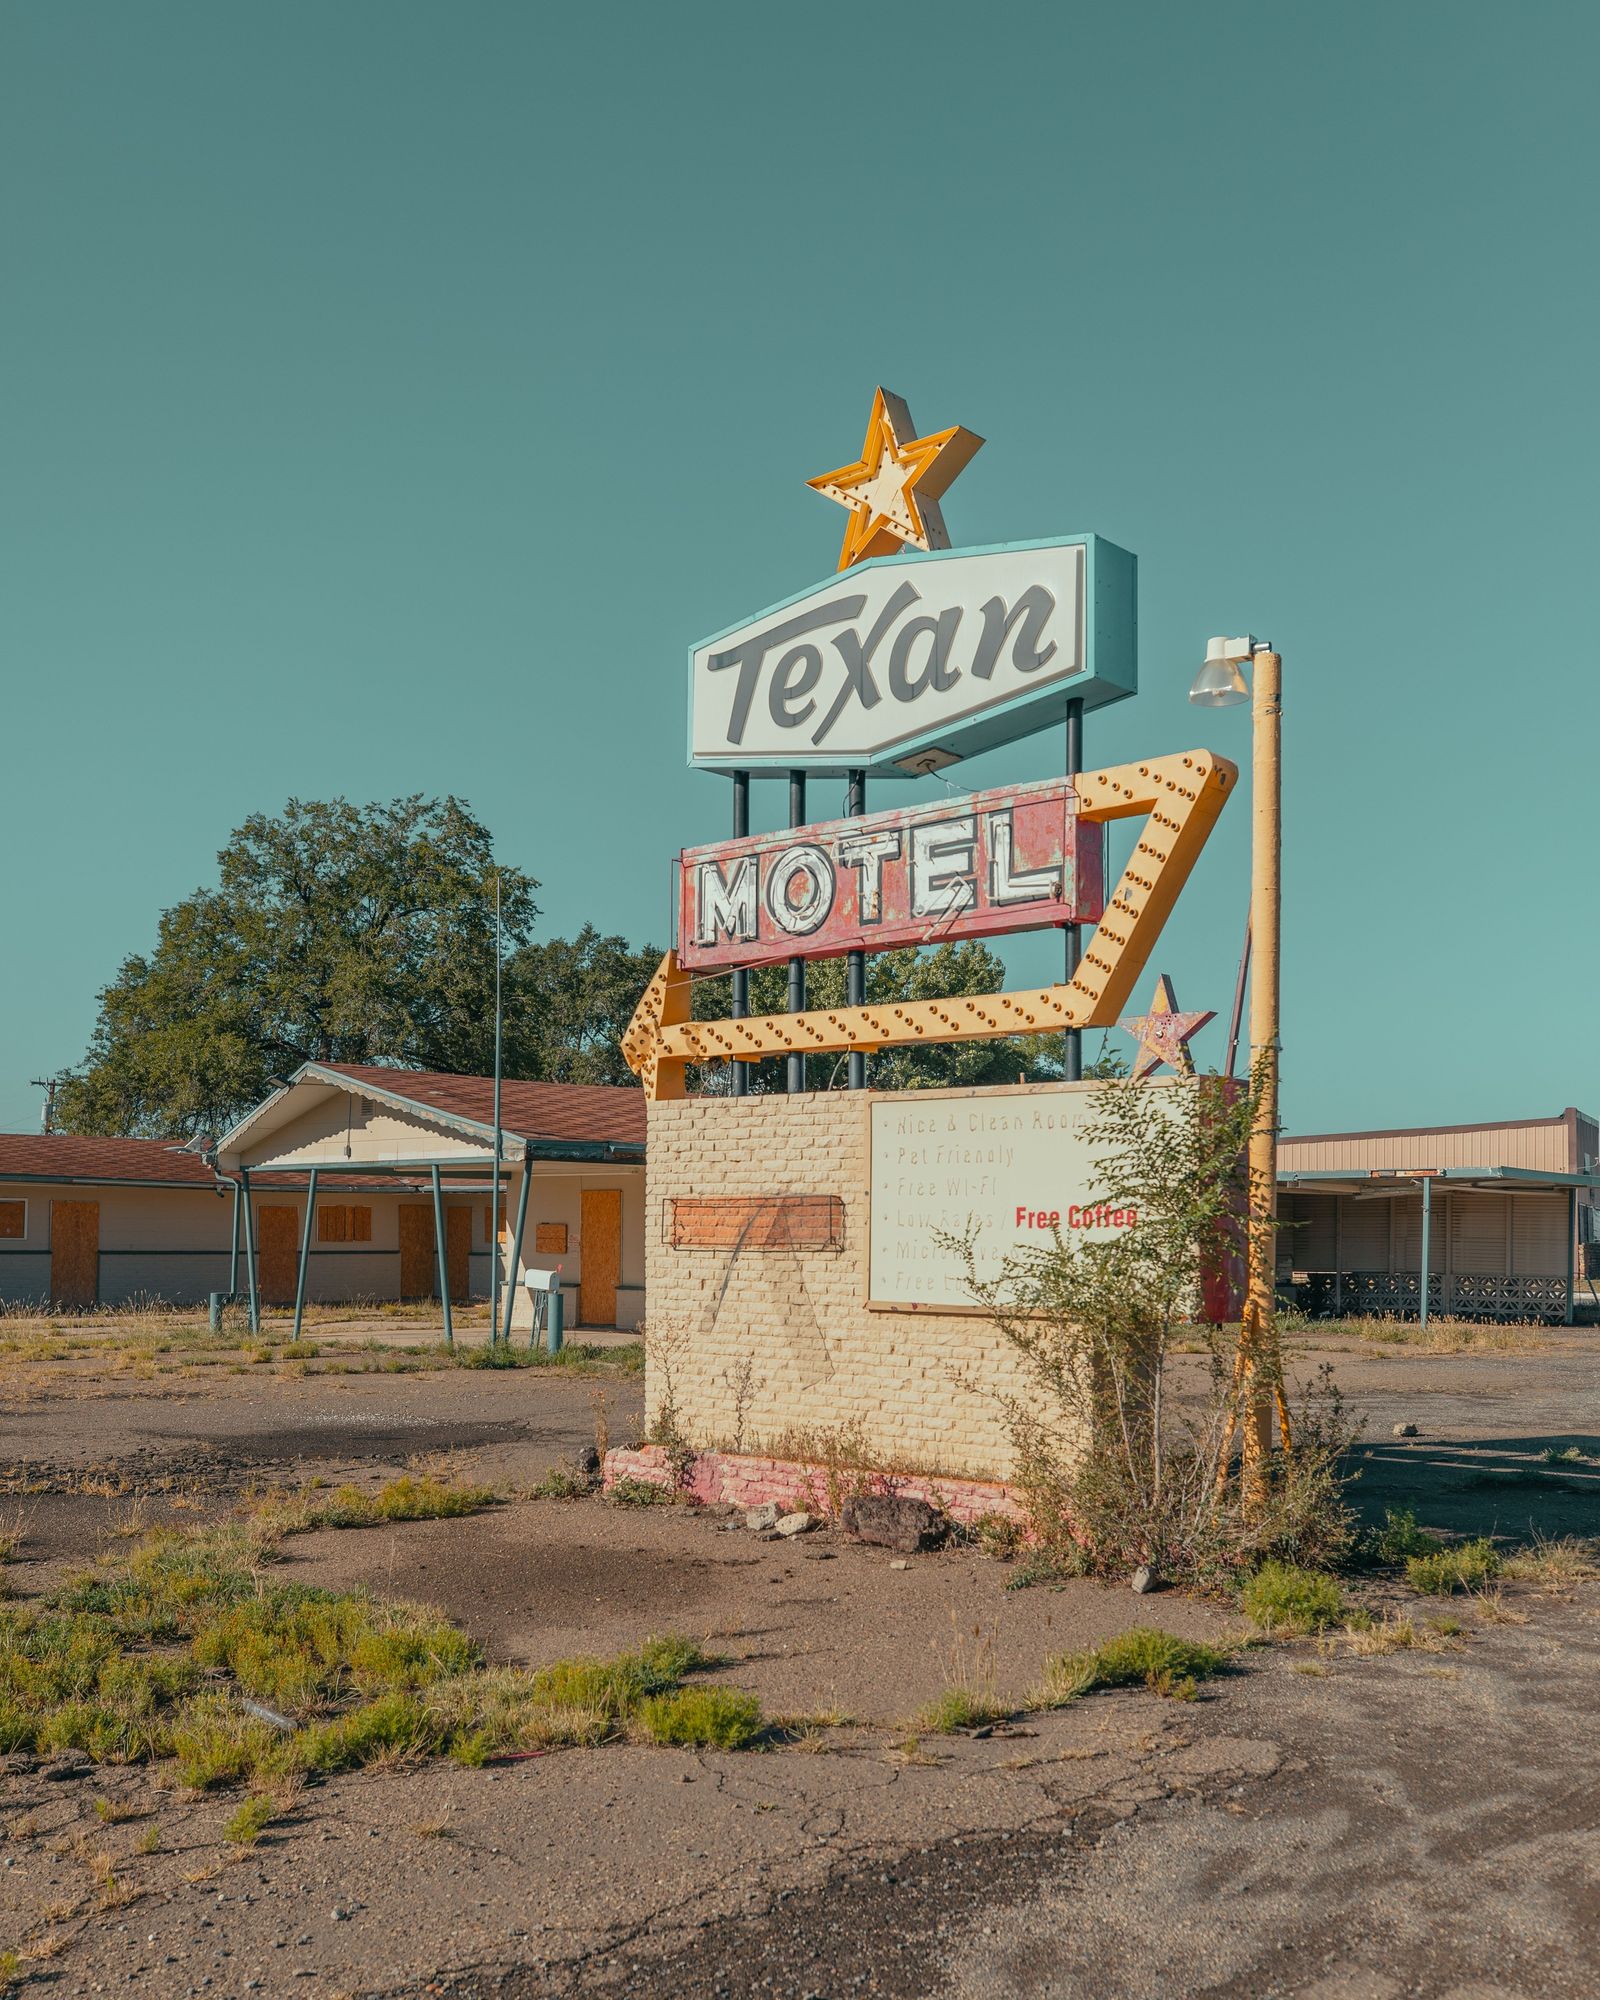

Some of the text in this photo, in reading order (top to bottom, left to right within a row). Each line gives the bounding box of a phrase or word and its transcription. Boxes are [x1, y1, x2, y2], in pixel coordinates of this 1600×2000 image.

[706, 579, 1059, 746] Texan
[696, 808, 1063, 945] MOTEL
[897, 1113, 937, 1135] Nice
[968, 1110, 1023, 1132] Clean
[897, 1143, 1014, 1168] Pet Friendly
[897, 1176, 936, 1197] Free
[896, 1207, 930, 1229] Low
[1015, 1206, 1060, 1229] Free
[1068, 1203, 1138, 1229] Coffee
[896, 1239, 999, 1261] Microwve
[895, 1271, 935, 1291] Free
